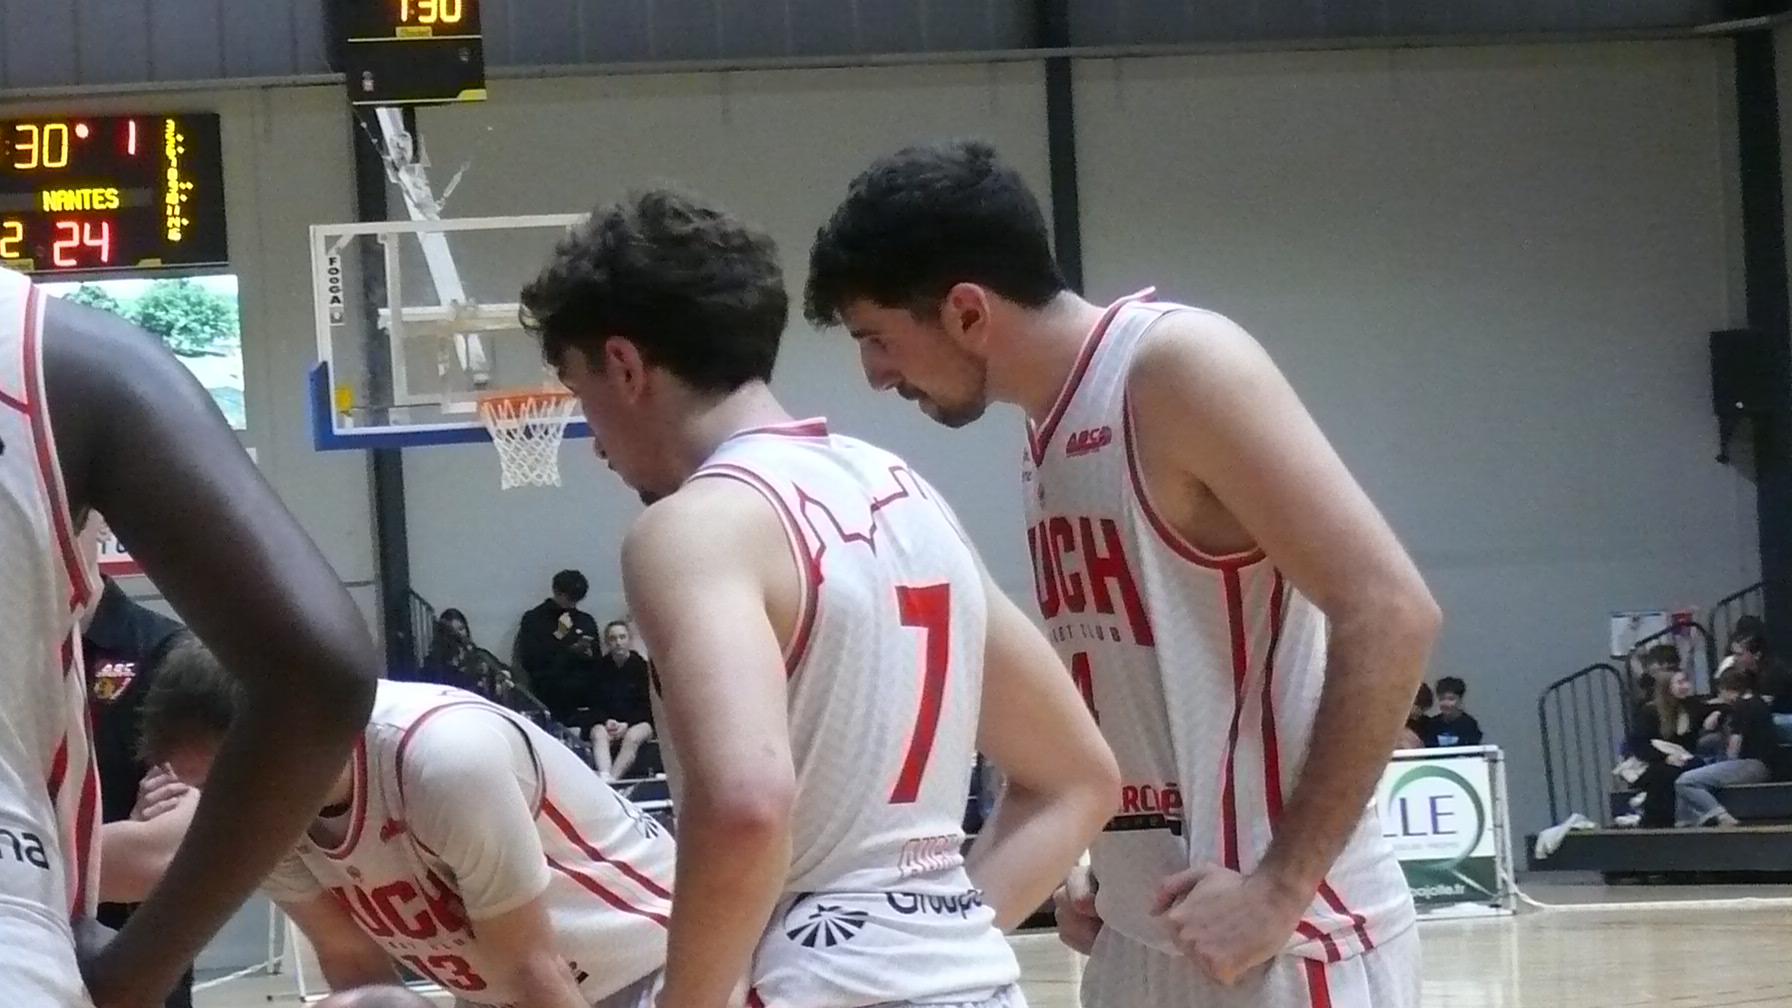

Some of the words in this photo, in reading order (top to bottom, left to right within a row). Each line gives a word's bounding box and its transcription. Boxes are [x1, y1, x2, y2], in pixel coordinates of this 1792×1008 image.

[42, 187, 120, 212] NANTES
[0, 220, 23, 258] 2
[53, 220, 110, 267] 24
[1028, 516, 1155, 648] UCH
[890, 583, 951, 803] 7
[1383, 794, 1458, 838] LE
[326, 868, 477, 941] UCH
[402, 953, 487, 992] 13
